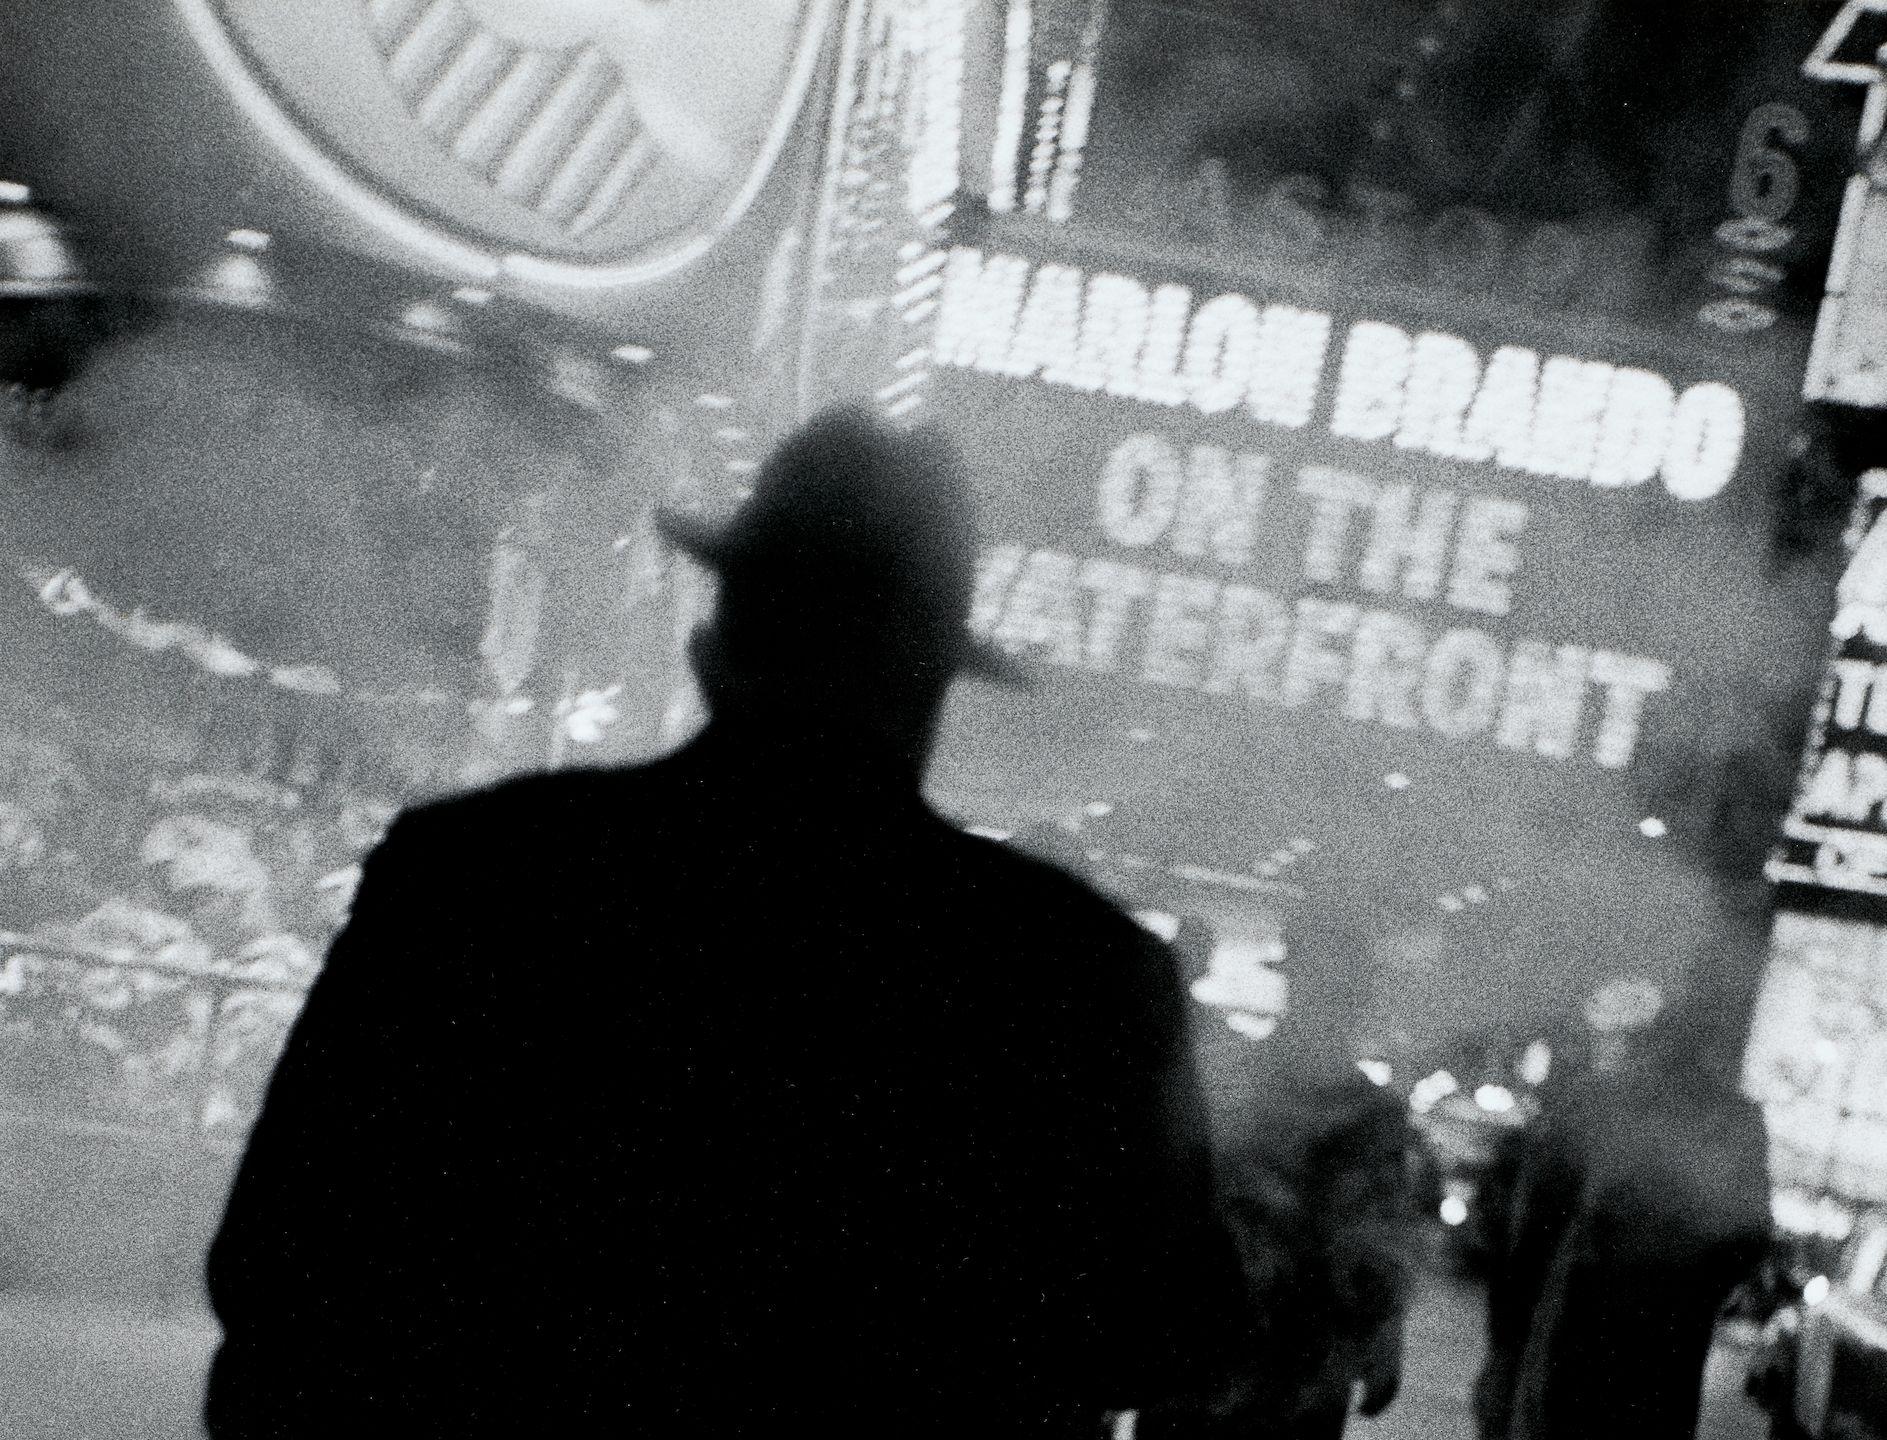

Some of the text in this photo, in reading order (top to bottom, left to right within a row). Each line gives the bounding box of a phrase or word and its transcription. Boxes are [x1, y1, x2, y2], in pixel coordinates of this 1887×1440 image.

[935, 246, 1746, 501] MARLON BRANDO
[1095, 433, 1530, 616] ON THE
